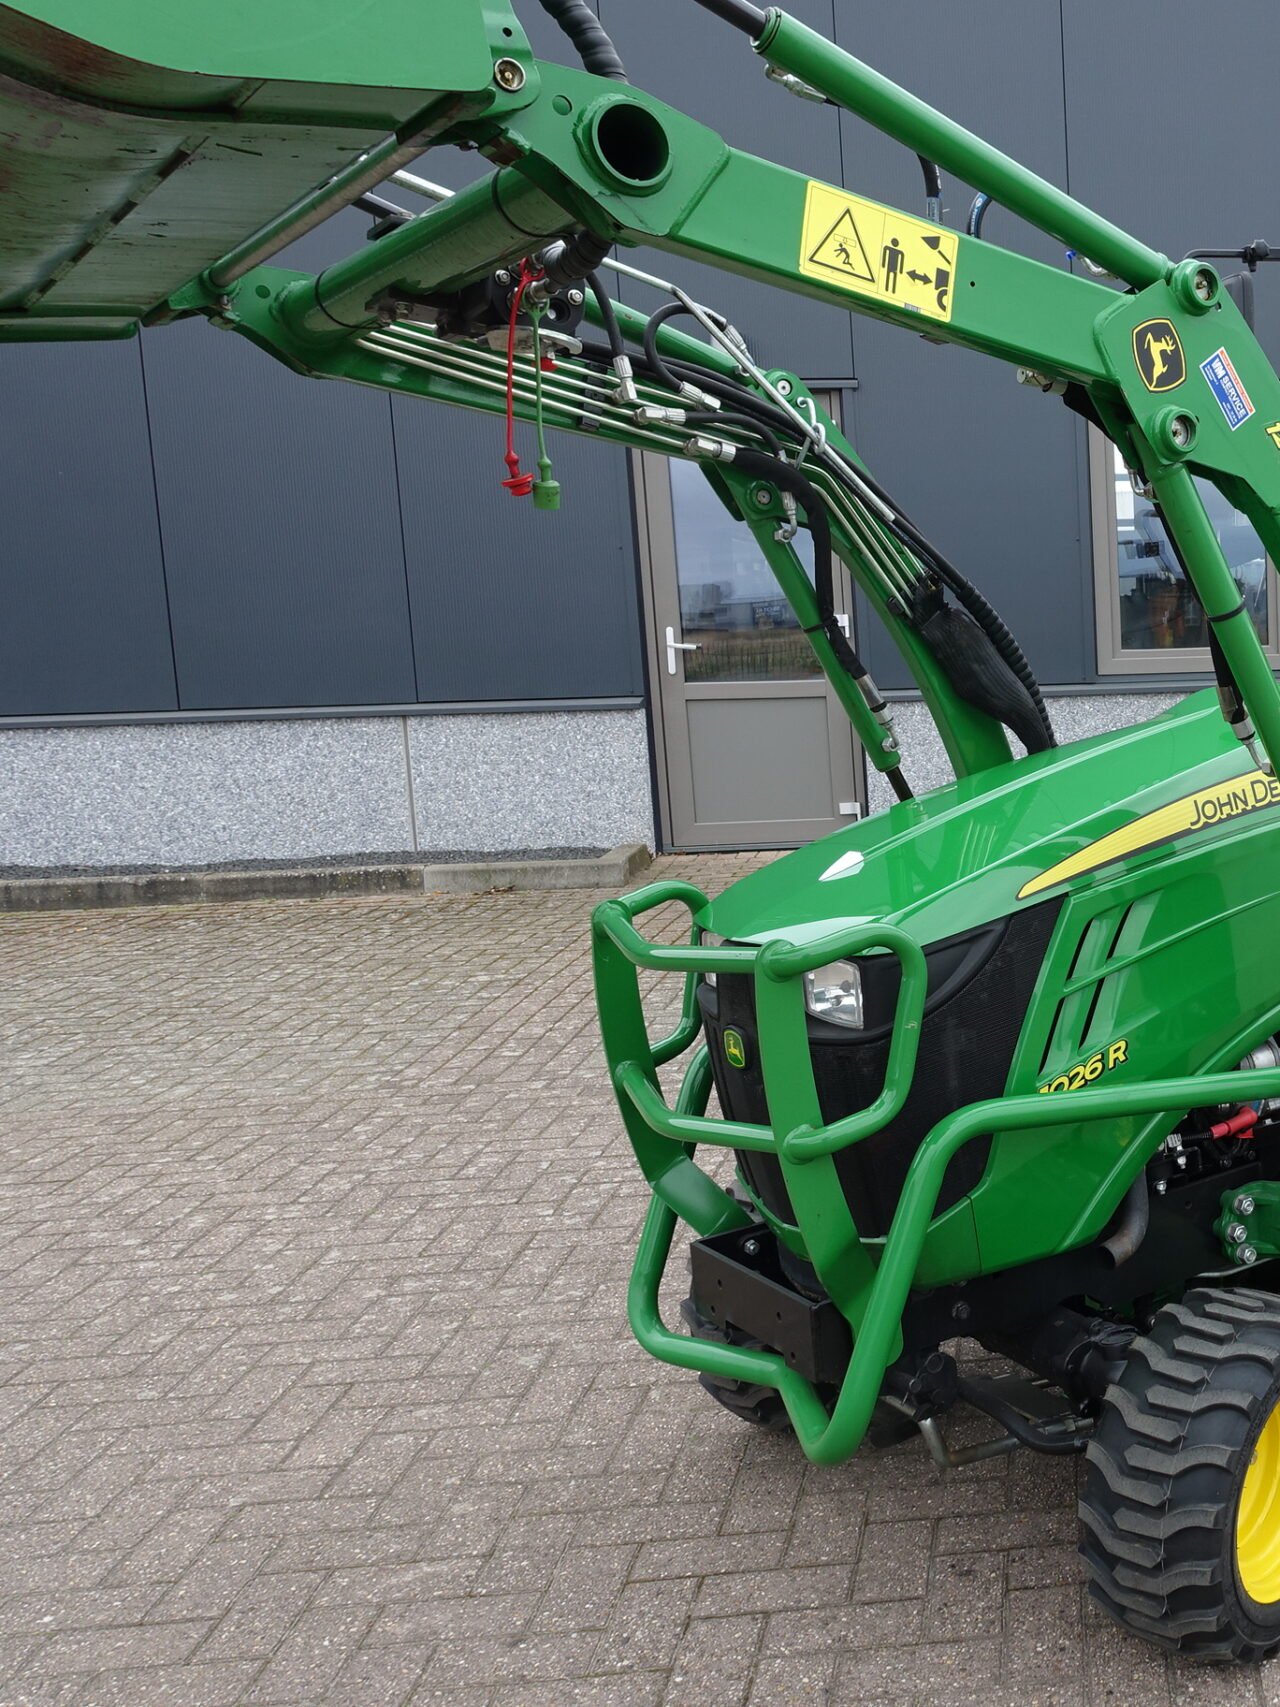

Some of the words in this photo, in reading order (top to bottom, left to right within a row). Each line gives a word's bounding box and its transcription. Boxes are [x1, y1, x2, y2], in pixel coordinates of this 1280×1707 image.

[1211, 357, 1226, 379] VM
[1222, 375, 1247, 417] SERVICE
[1190, 788, 1249, 827] JOHN
[1107, 1039, 1129, 1070] R
